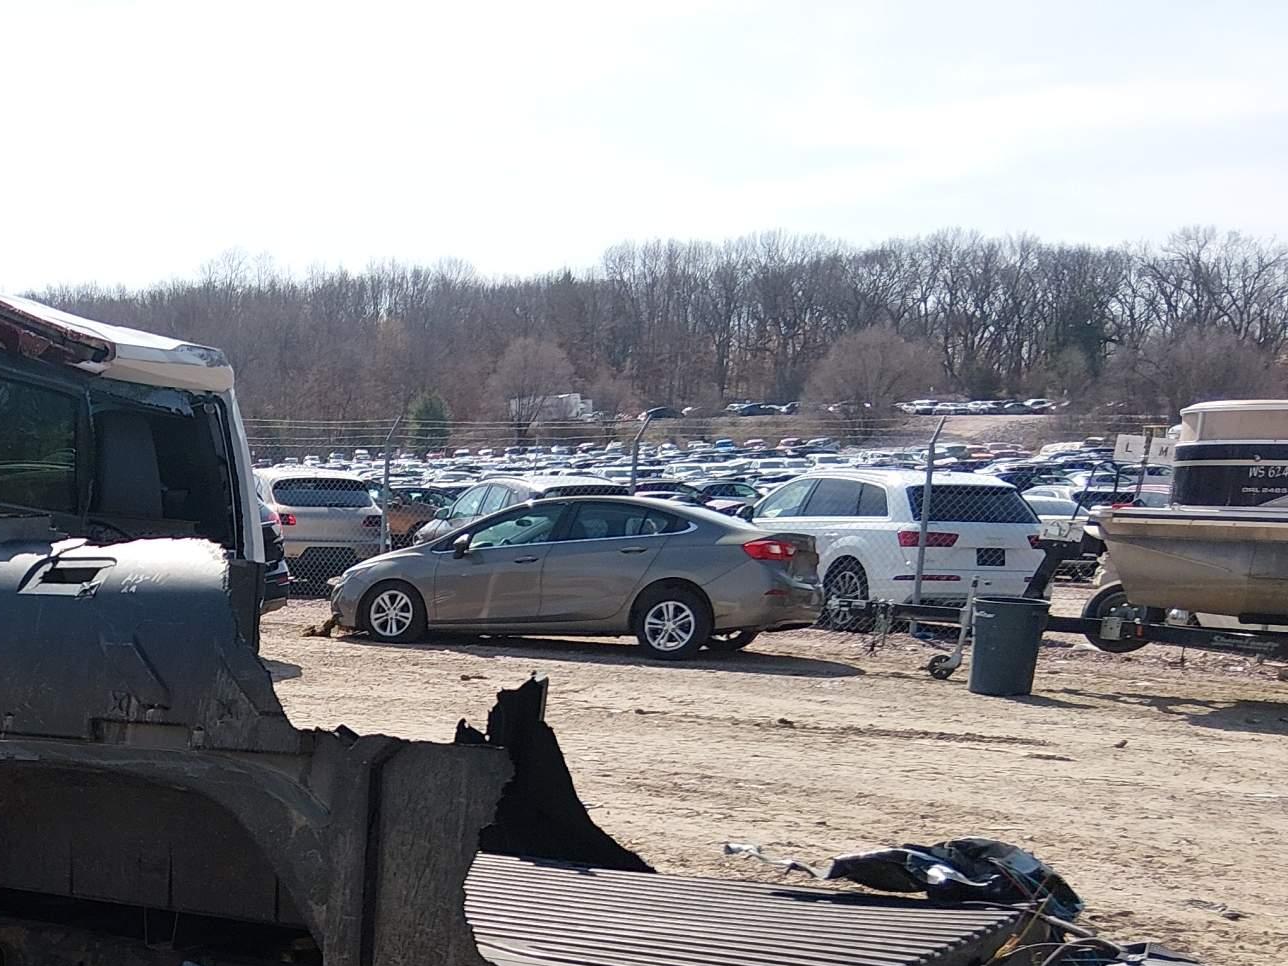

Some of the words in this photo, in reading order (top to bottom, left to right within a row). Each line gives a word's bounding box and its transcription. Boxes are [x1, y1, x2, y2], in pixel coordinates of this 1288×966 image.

[1125, 441, 1133, 452] L
[1158, 446, 1169, 456] M
[1249, 466, 1265, 478] WS
